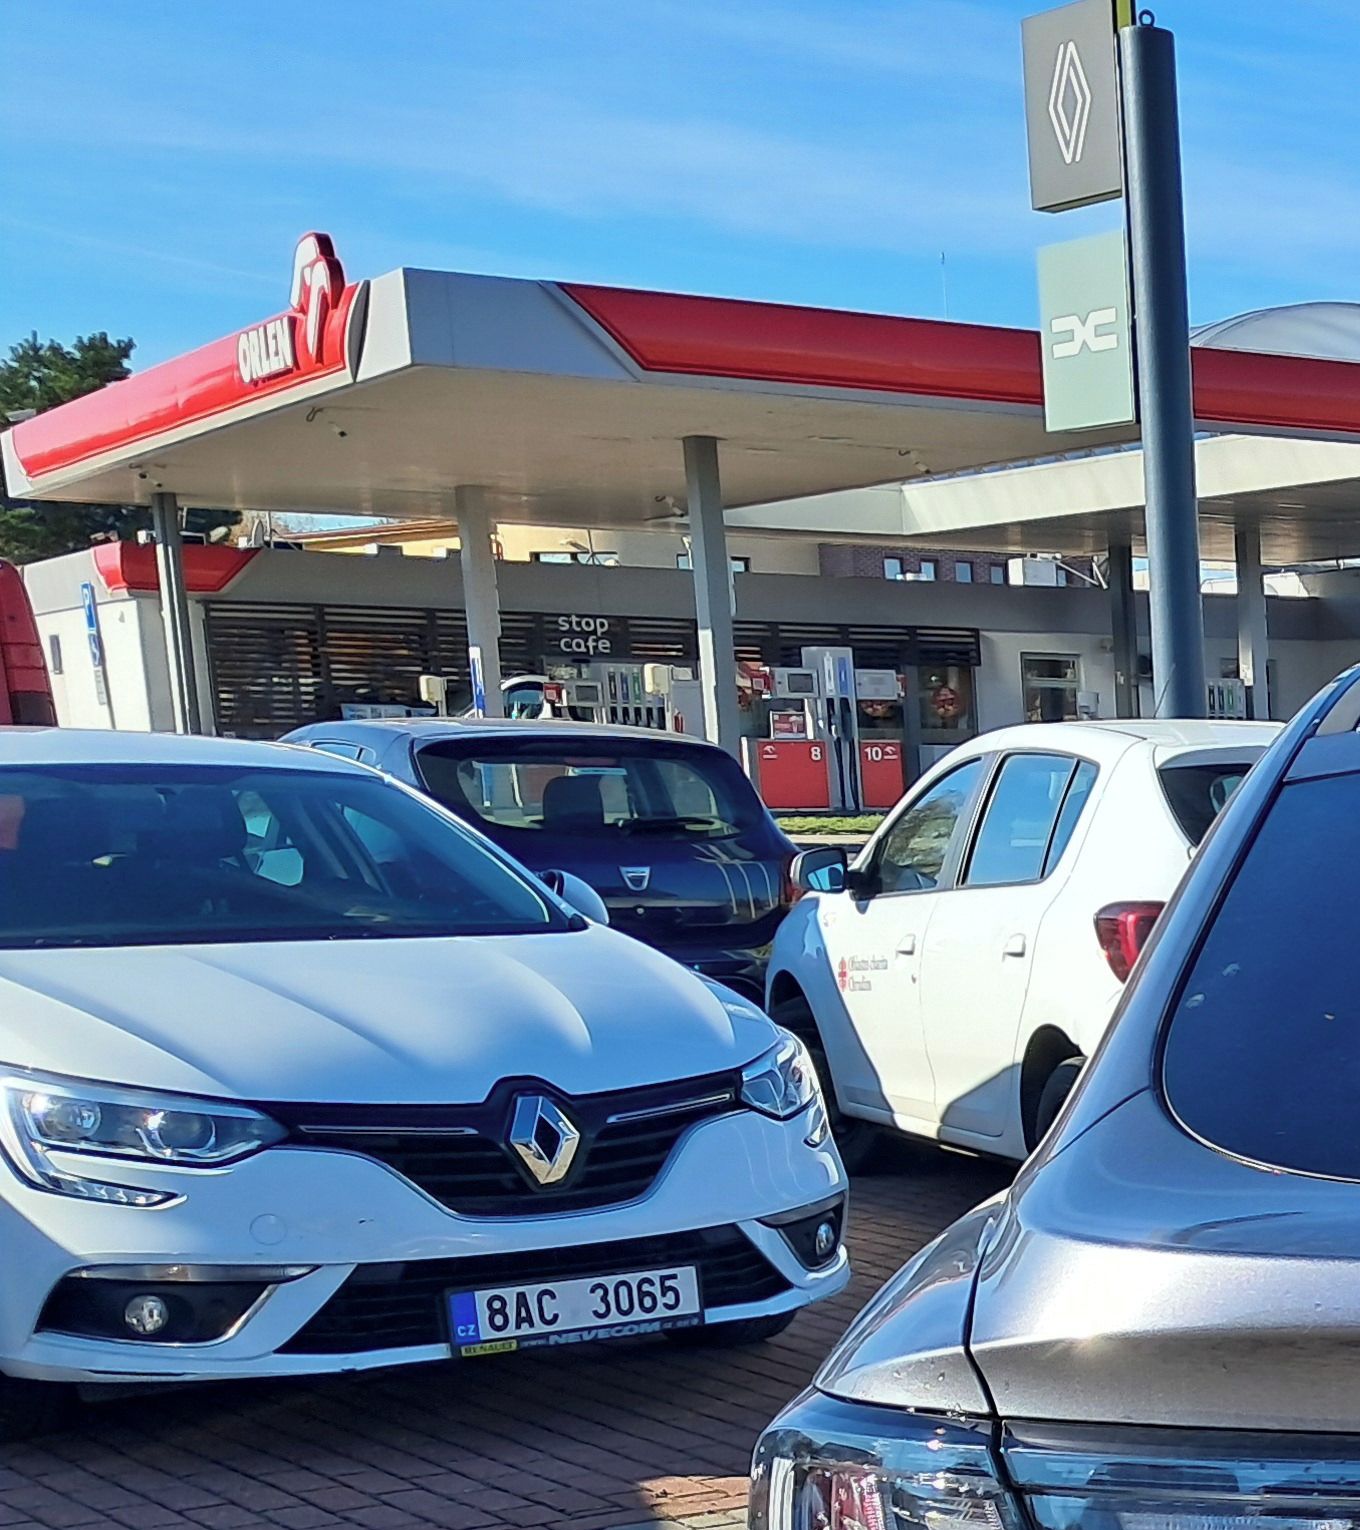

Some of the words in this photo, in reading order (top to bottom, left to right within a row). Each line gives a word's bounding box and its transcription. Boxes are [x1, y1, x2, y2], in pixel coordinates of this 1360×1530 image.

[238, 315, 293, 383] ORLEN
[557, 615, 609, 636] stop
[560, 635, 611, 655] cafe
[811, 746, 821, 761] 8
[864, 746, 882, 761] 10
[486, 1288, 559, 1332] 8AC
[589, 1274, 681, 1319] 3065
[457, 1325, 476, 1336] CZ
